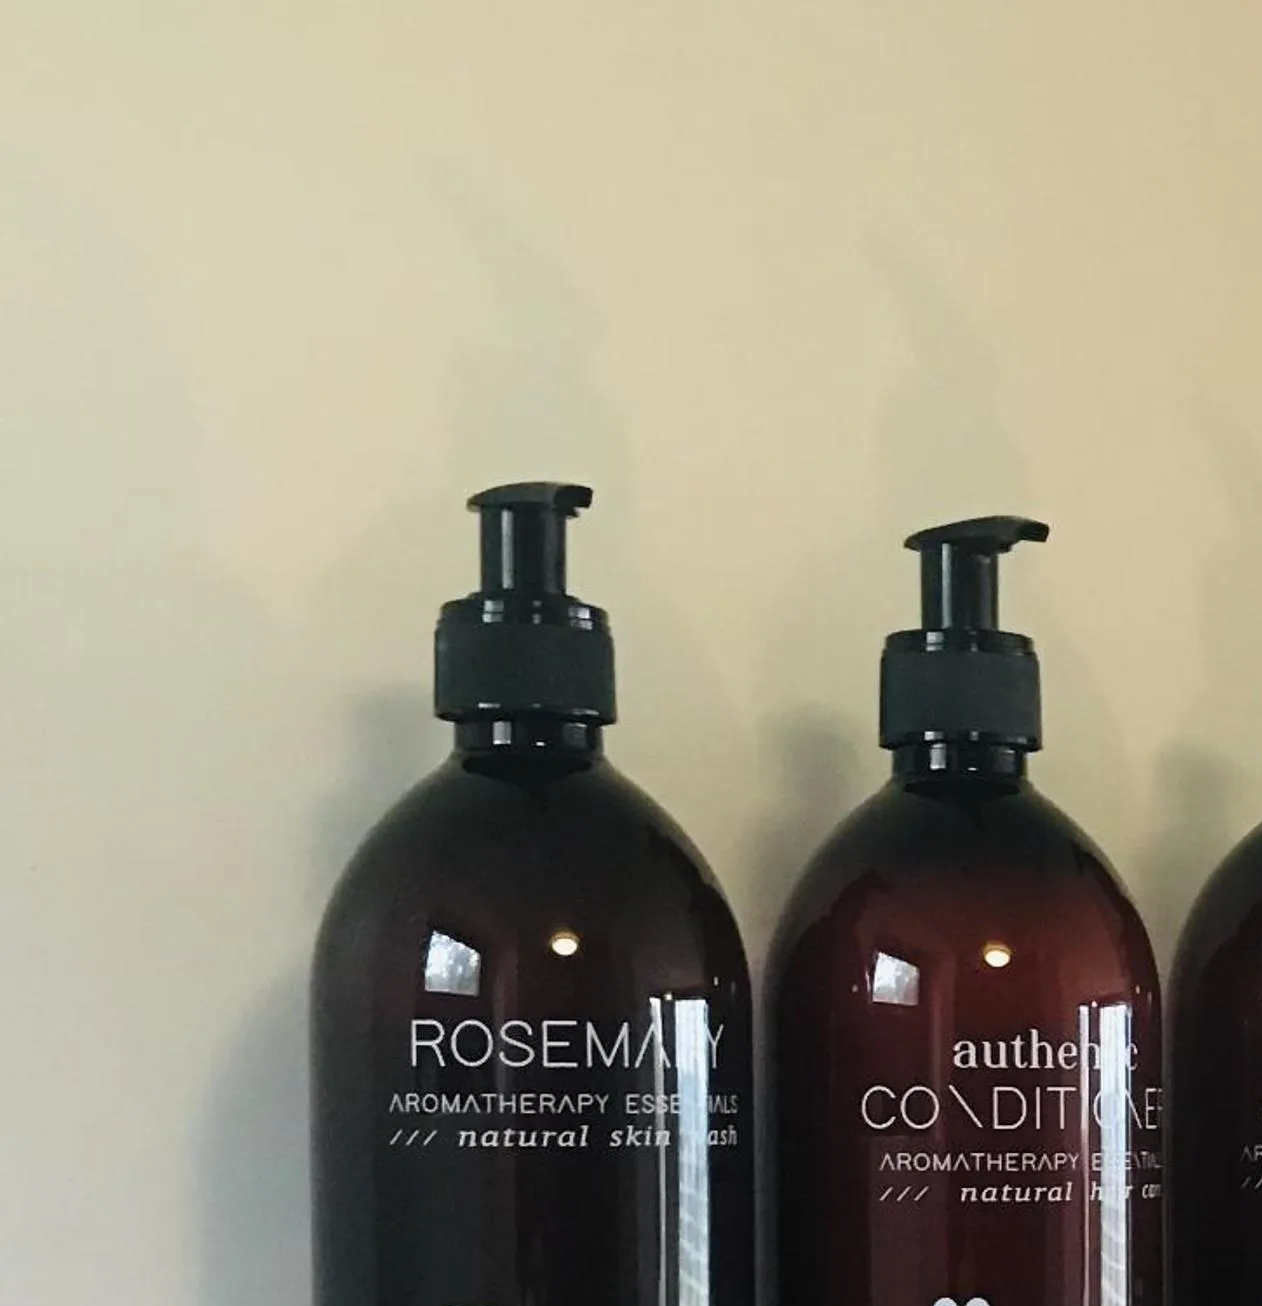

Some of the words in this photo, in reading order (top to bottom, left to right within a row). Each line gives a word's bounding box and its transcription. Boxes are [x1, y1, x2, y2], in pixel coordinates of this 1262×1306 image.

[410, 1019, 724, 1069] ROSEMAY
[953, 1028, 1138, 1070] authenc
[389, 1093, 609, 1115] AROMATHERAPY
[625, 1093, 739, 1115] ESSEIALS
[458, 1125, 589, 1148] natural
[609, 1124, 671, 1148] skin
[697, 1124, 738, 1147] ash
[878, 1152, 1080, 1172] AROMATHERAPY
[960, 1182, 1073, 1203] natural
